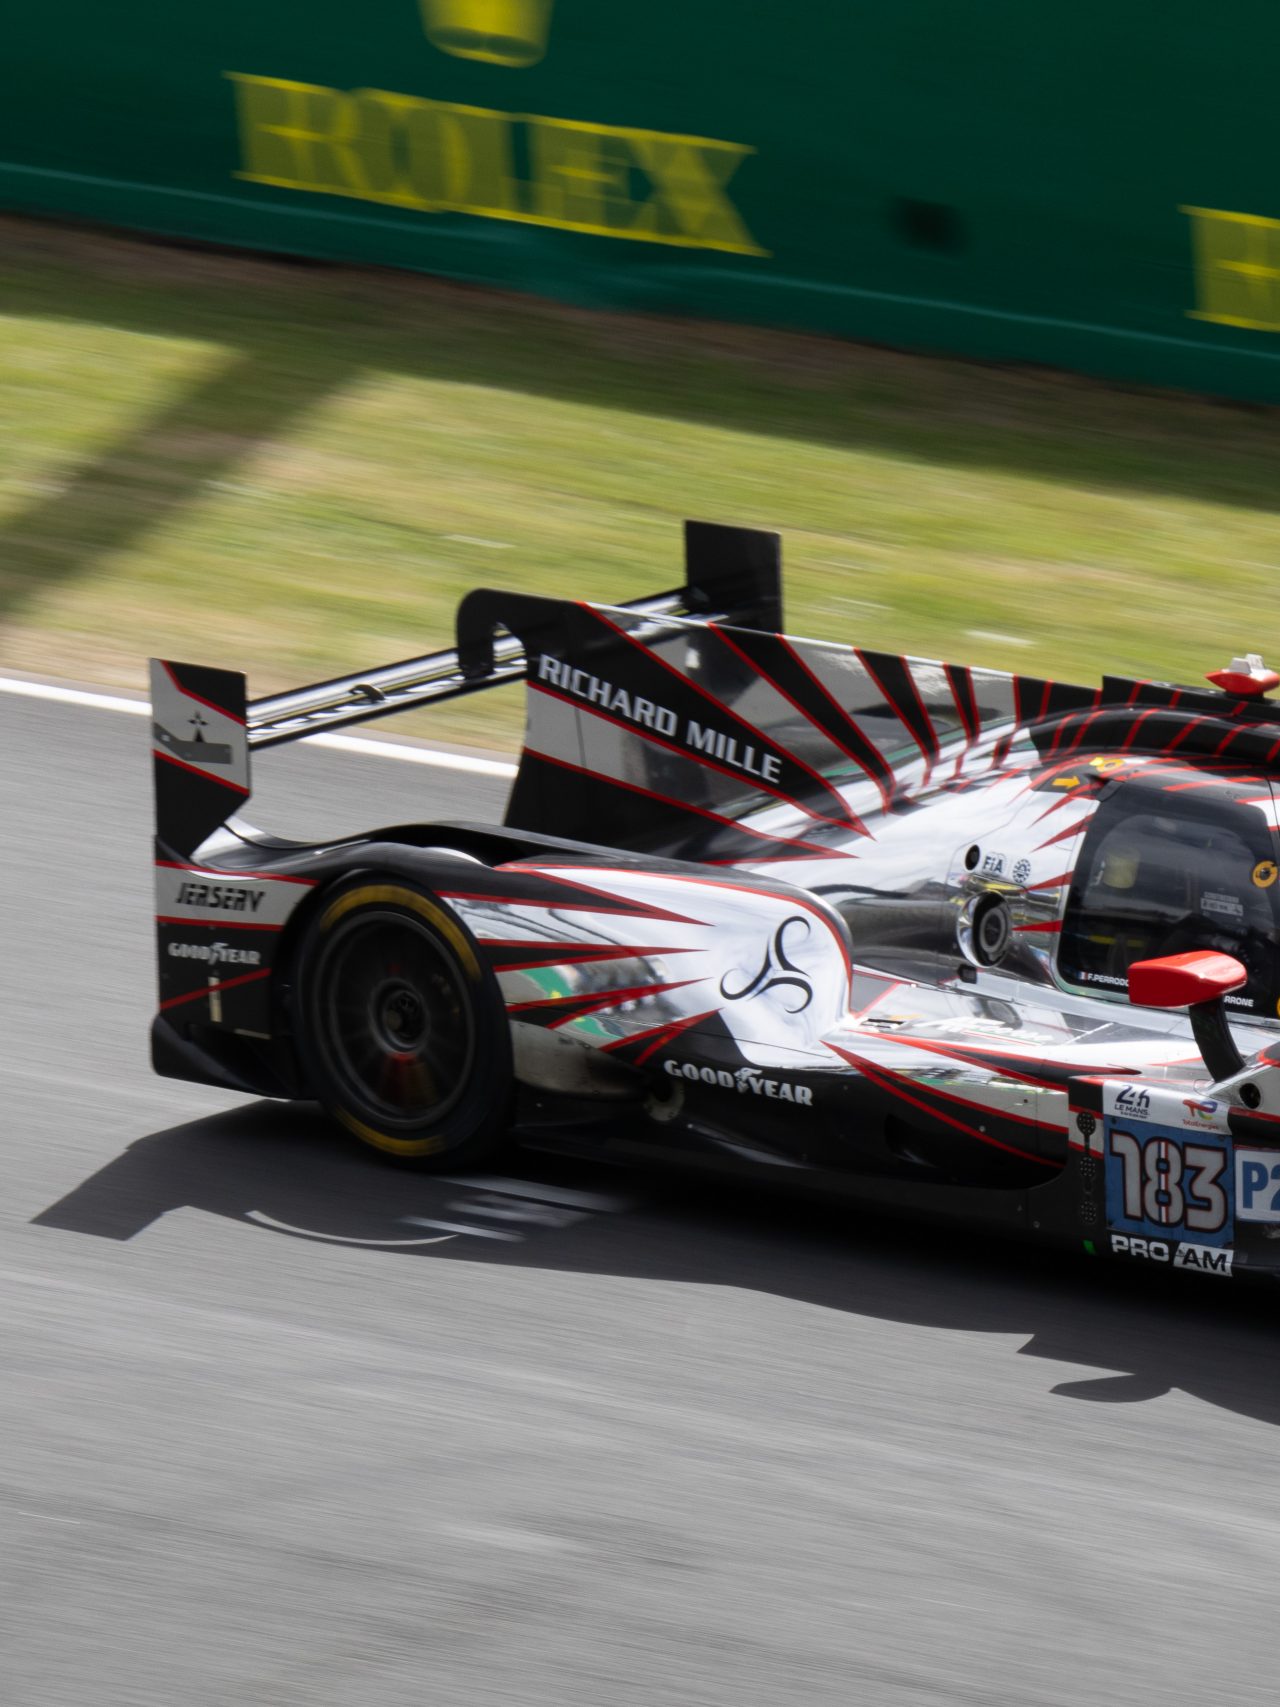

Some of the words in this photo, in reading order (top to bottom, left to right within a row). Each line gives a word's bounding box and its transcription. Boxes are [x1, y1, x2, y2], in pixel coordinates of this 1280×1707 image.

[222, 71, 771, 257] ROLEX
[538, 653, 677, 738] RICHARD
[685, 721, 783, 784] MILLE
[175, 882, 265, 912] JERSERV
[168, 942, 261, 965] GOODYEAR
[664, 1060, 813, 1106] GOODYEAR
[1109, 1128, 1228, 1234] 183
[1111, 1234, 1169, 1262] PRO
[1182, 1247, 1227, 1273] AM
